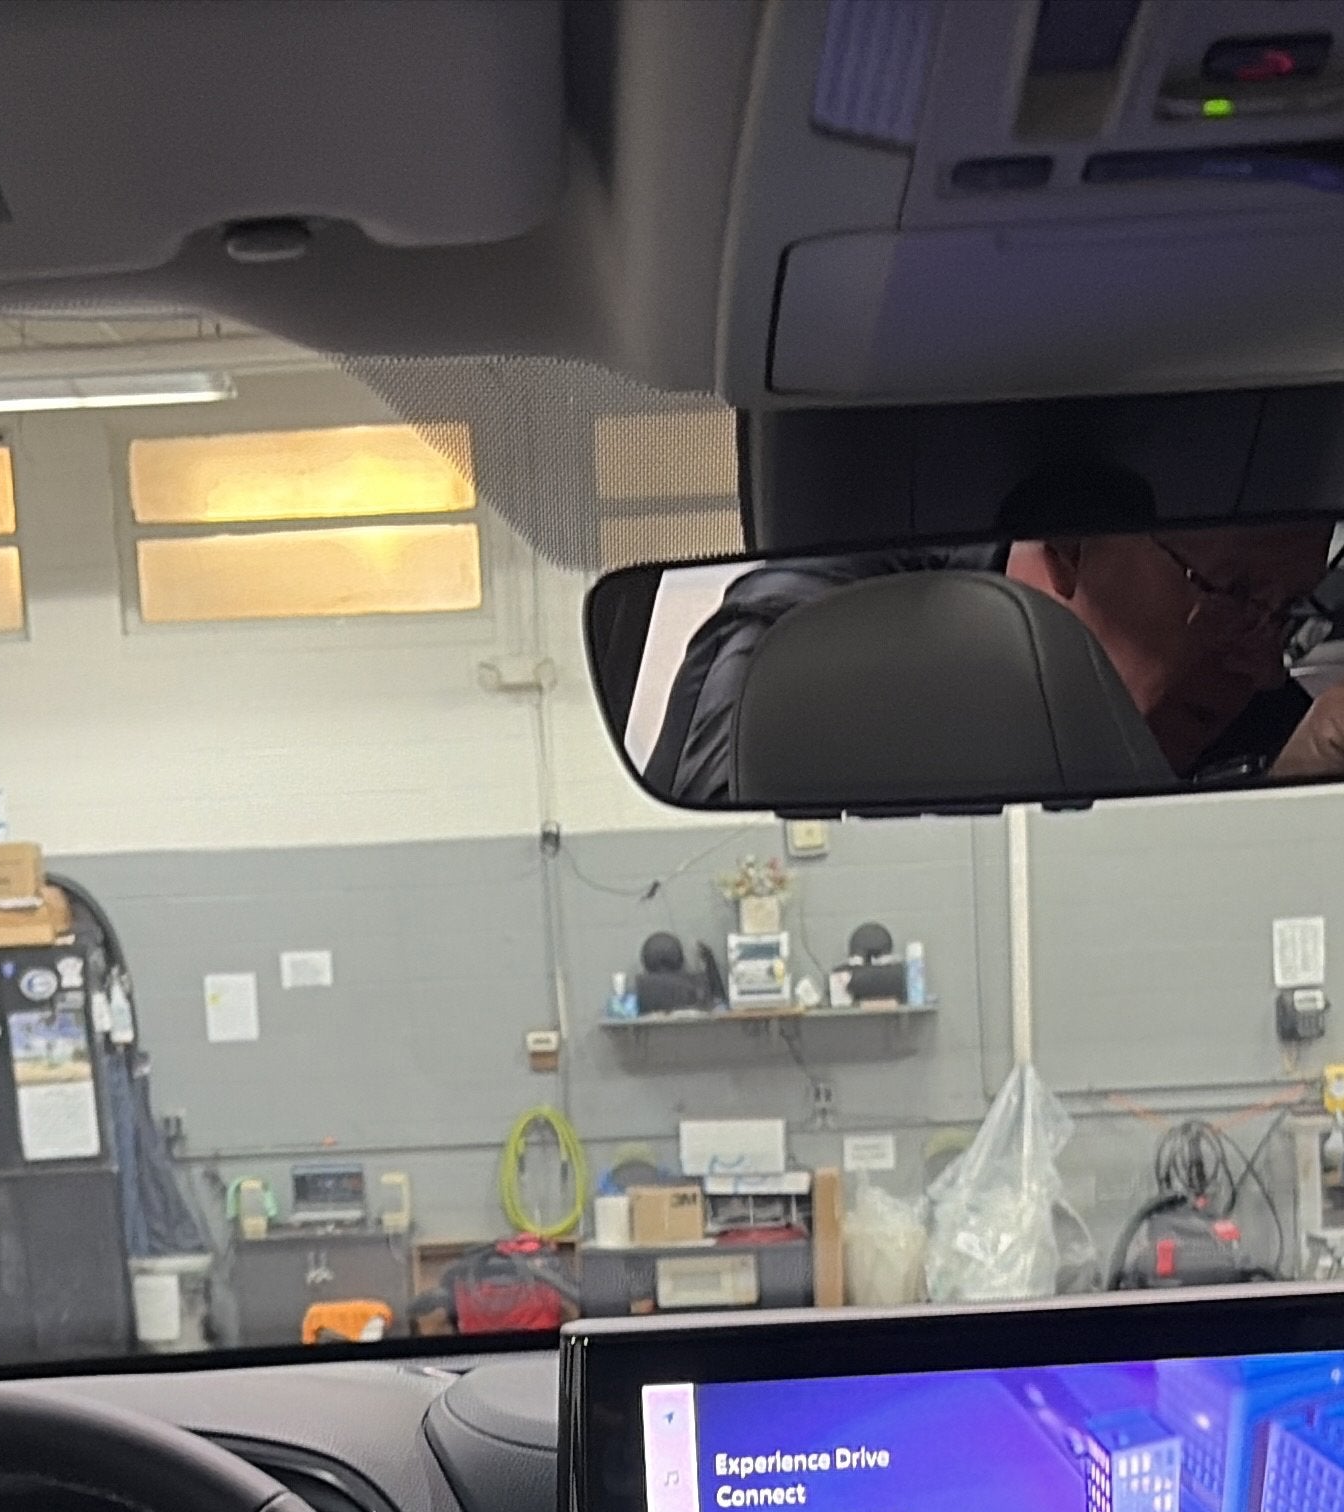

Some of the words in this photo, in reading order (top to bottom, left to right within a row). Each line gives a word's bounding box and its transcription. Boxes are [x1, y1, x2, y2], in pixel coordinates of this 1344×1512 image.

[715, 1451, 831, 1478] Experience
[835, 1446, 890, 1469] Drive
[716, 1483, 806, 1508] Connect
